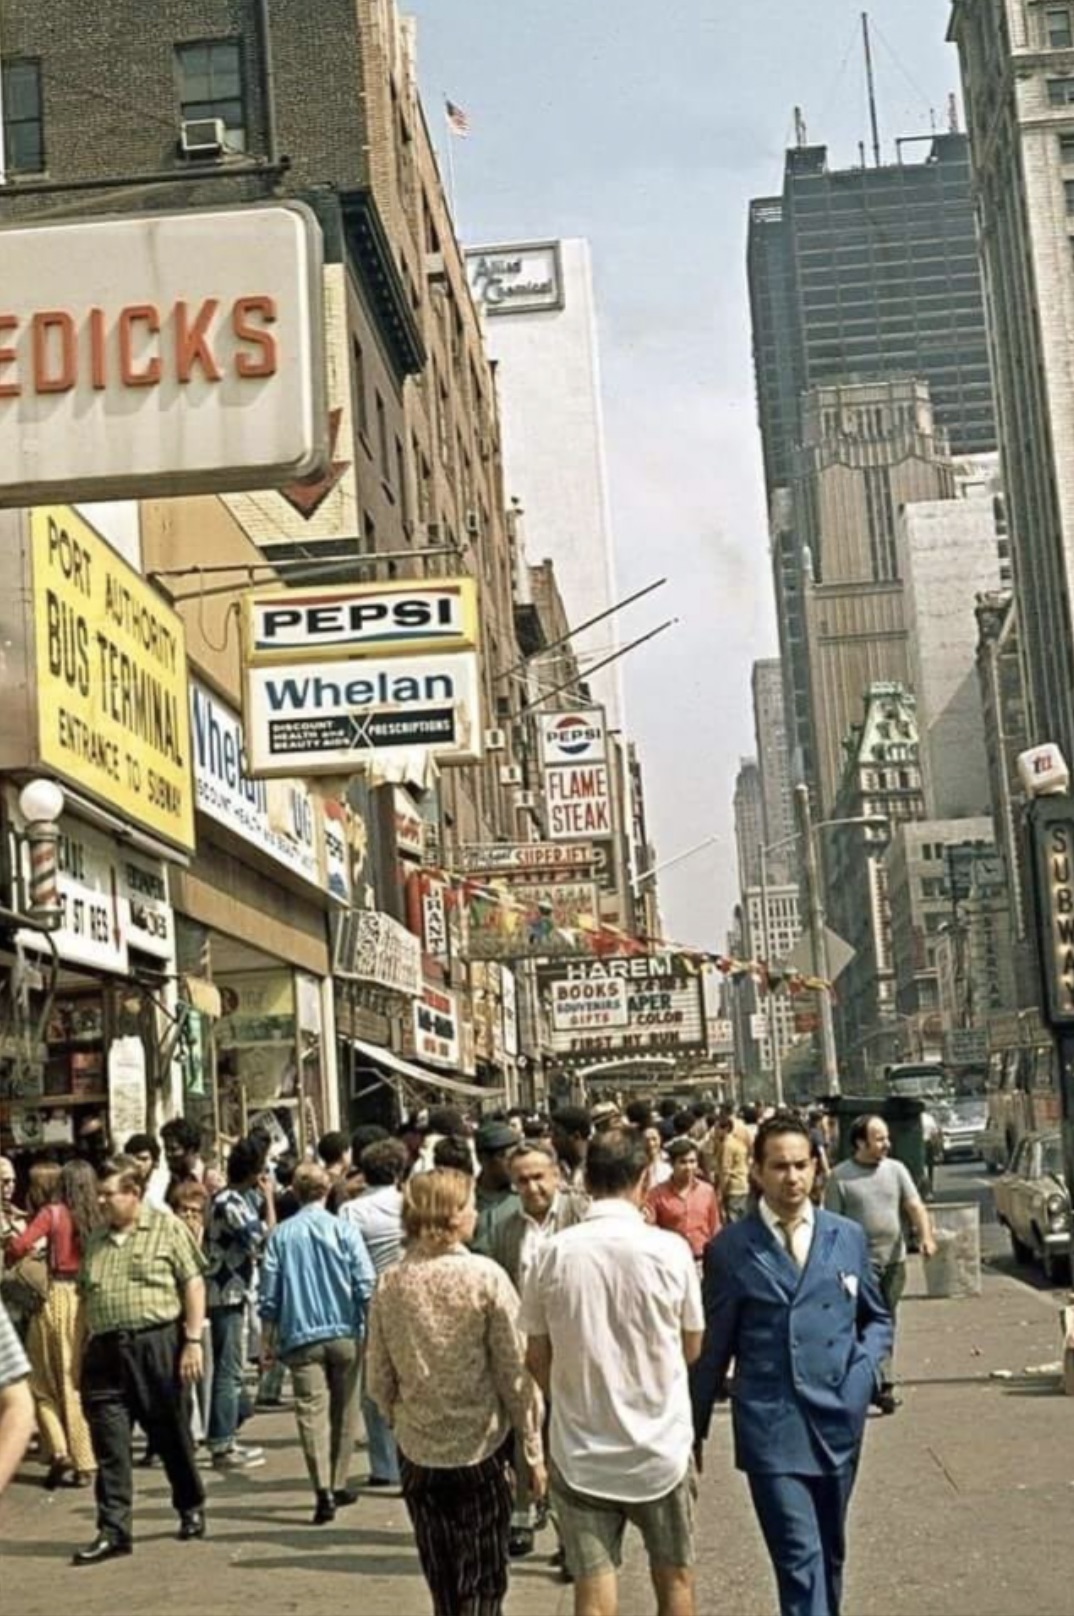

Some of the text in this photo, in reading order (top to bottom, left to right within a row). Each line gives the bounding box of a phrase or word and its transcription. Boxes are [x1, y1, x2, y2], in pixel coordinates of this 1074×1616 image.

[48, 515, 178, 674] PORT AUTHORITY
[263, 598, 452, 637] PEPSI
[47, 588, 185, 769] BUS TERMINAL
[264, 672, 454, 711] Whelan
[273, 721, 333, 731] DISCOUNT
[368, 719, 451, 736] PRESCRIPTIONS
[546, 728, 601, 742] PEPSI
[273, 732, 318, 740] HEALTH
[274, 740, 319, 749] BEAUTY
[59, 707, 121, 782] ENTRANCE
[126, 754, 142, 793] TO
[548, 767, 607, 801] FLAME
[551, 801, 609, 834] STEAK
[566, 956, 673, 980] HAREM
[556, 981, 620, 1001] BOOKS
[556, 999, 621, 1014] SOUVENIRS
[569, 1012, 610, 1025] GIFTS
[636, 1010, 684, 1026] COLOR
[570, 1034, 613, 1050] FIRST
